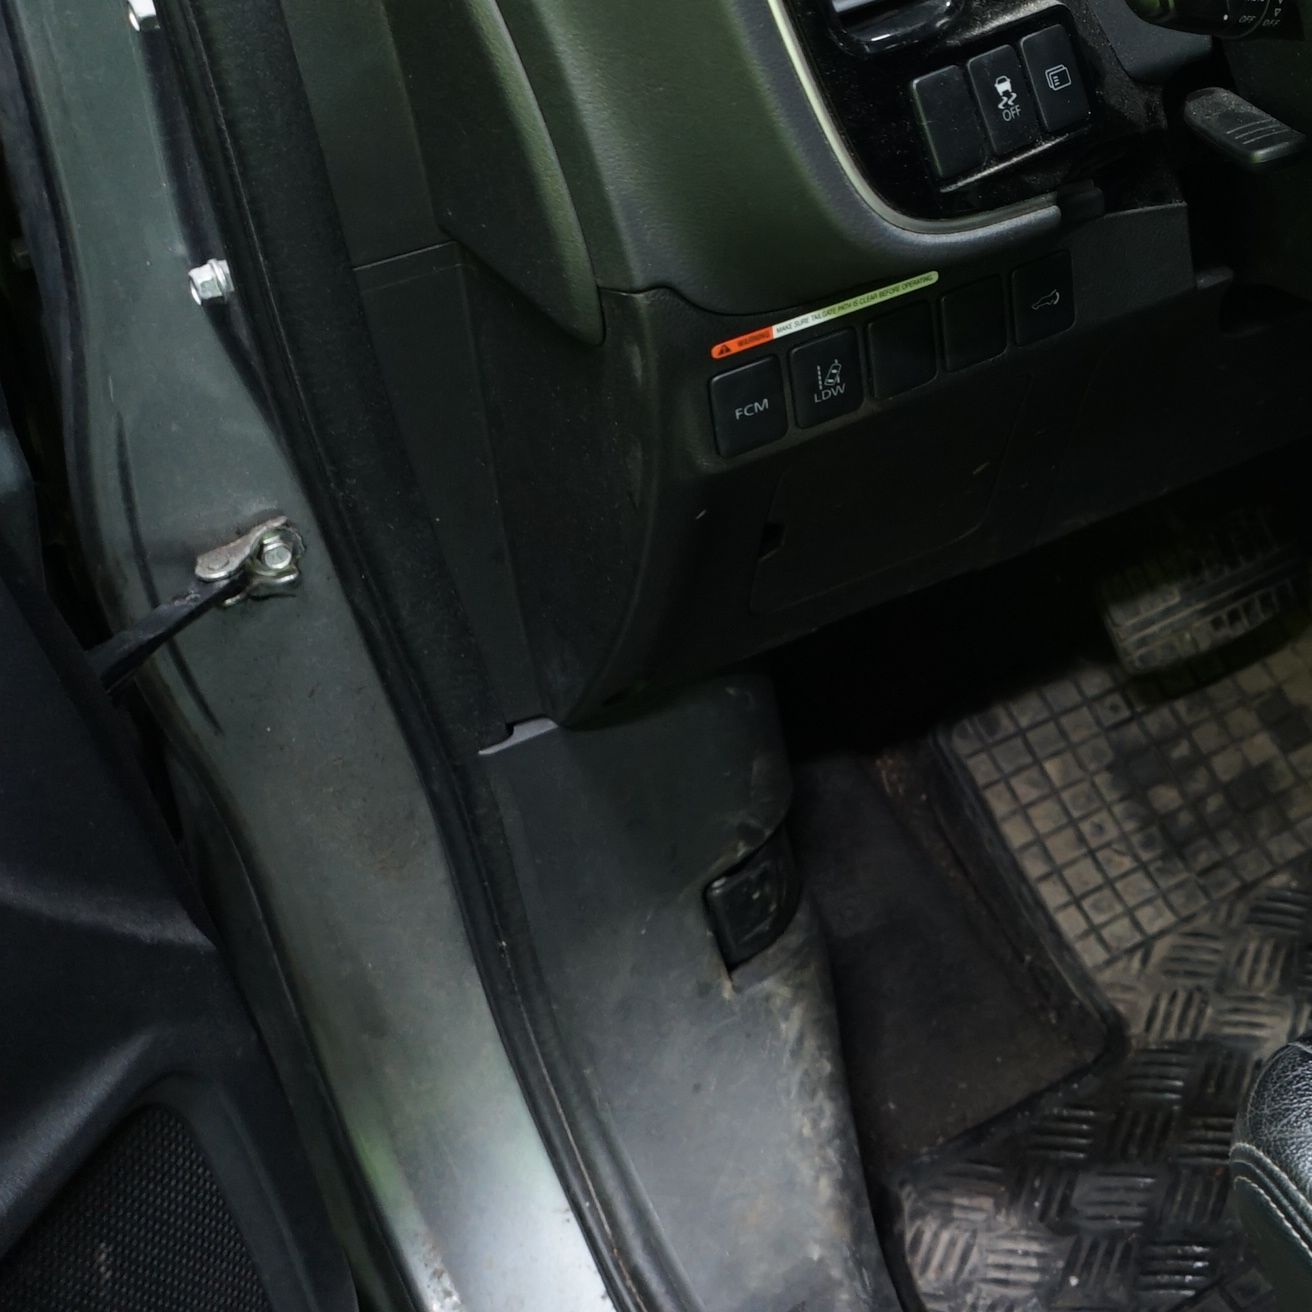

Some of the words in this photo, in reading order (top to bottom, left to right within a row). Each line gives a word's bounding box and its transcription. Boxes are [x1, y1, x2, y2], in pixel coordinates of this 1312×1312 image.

[1239, 15, 1256, 24] OFF
[1262, 19, 1281, 27] OFF
[1002, 104, 1022, 122] OFF
[814, 383, 846, 403] LDW
[735, 398, 769, 421] FCM
